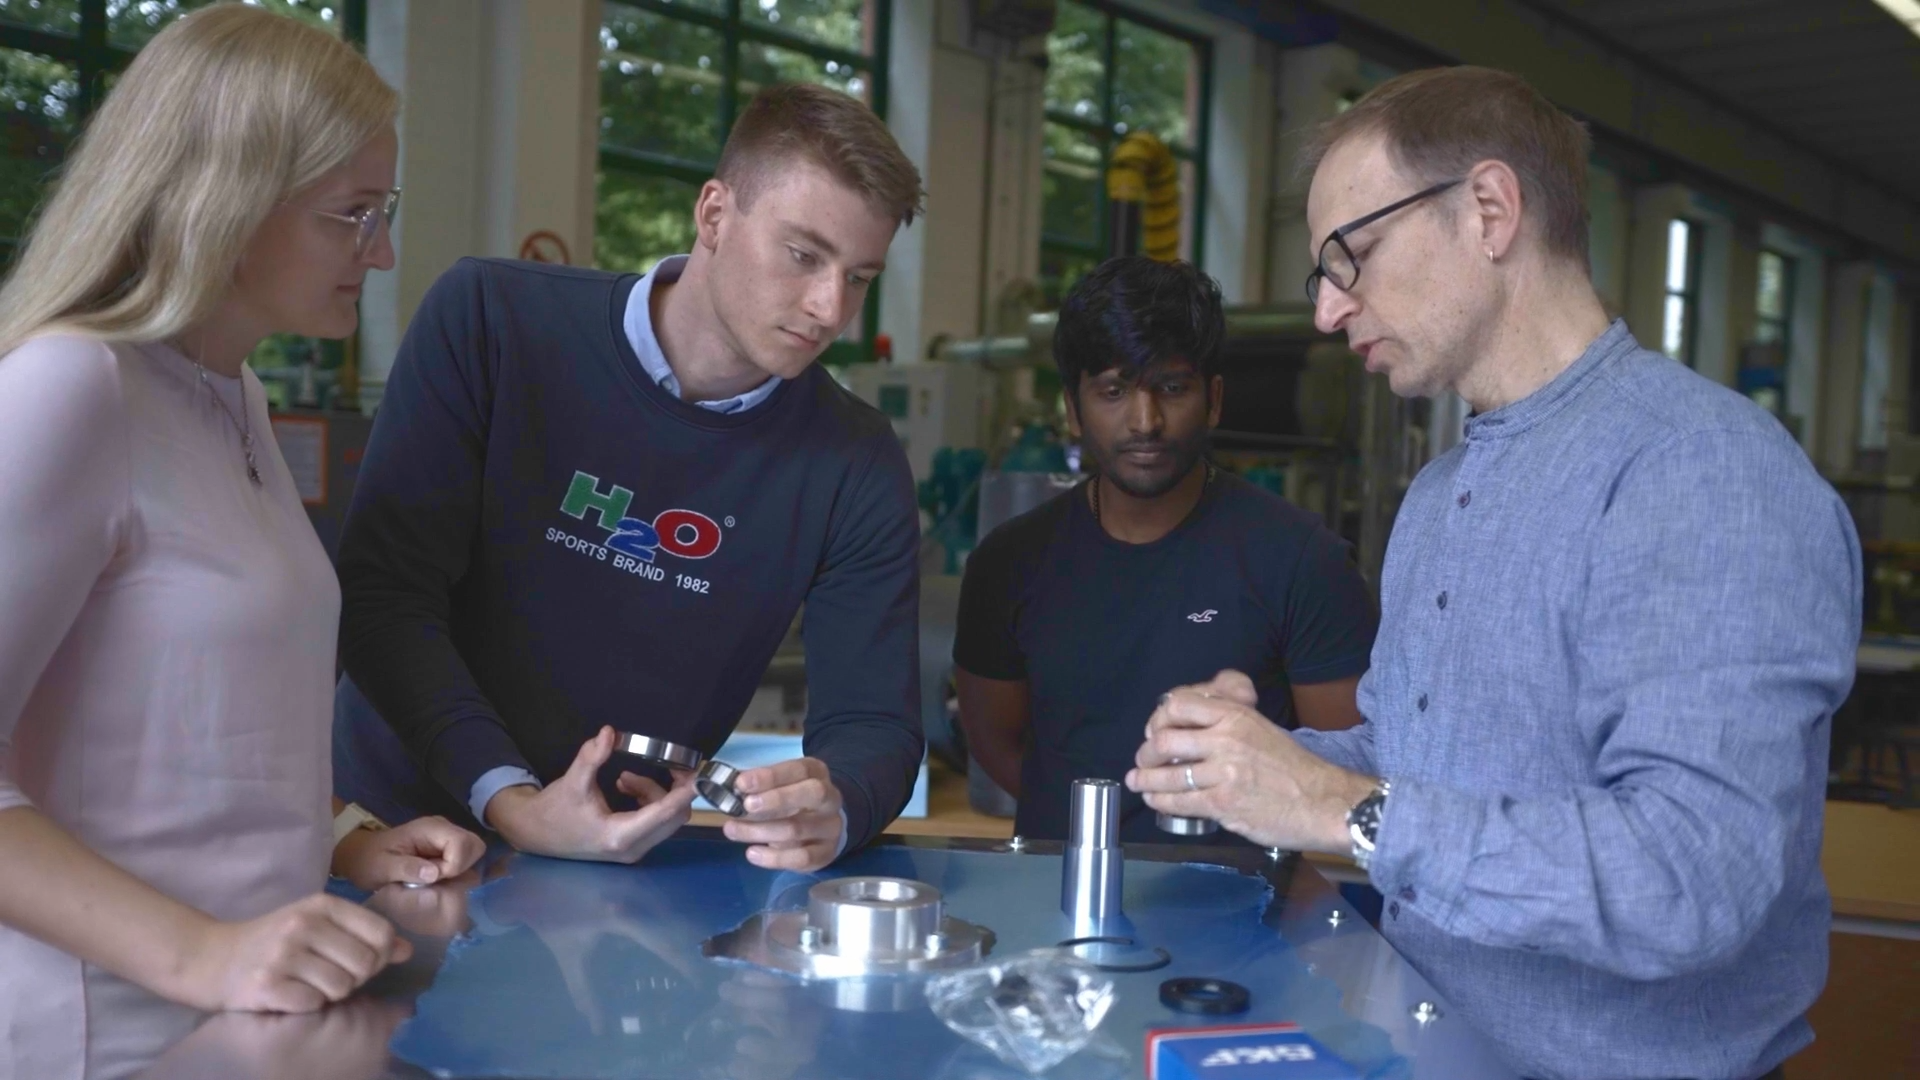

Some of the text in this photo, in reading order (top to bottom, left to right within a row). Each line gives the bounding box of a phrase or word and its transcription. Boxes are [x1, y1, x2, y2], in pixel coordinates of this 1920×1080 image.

[560, 470, 722, 563] H2O
[545, 527, 710, 594] SPORTS BRAND 1982
